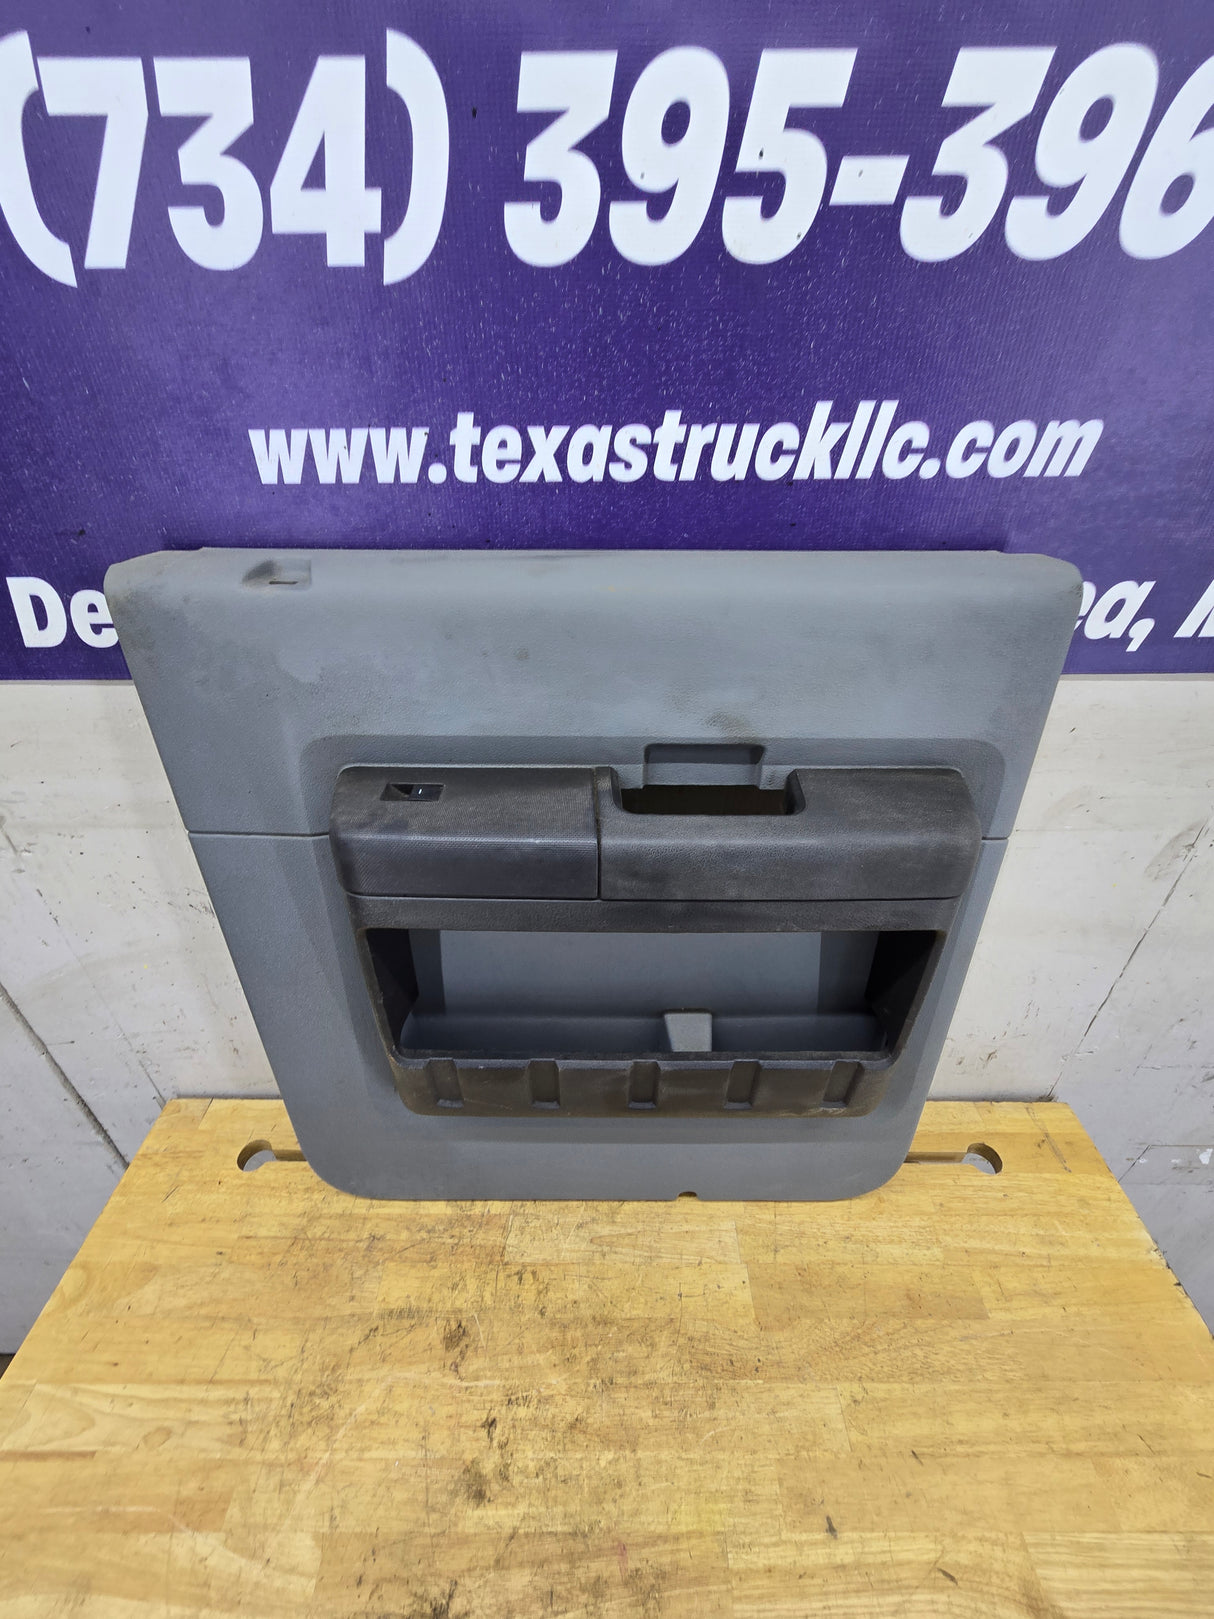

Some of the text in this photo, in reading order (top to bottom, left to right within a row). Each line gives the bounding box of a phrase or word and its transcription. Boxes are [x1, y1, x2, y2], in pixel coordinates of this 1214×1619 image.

[0, 29, 1214, 288] (734) 395-396
[248, 399, 1104, 485] www.texastruckllc.com
